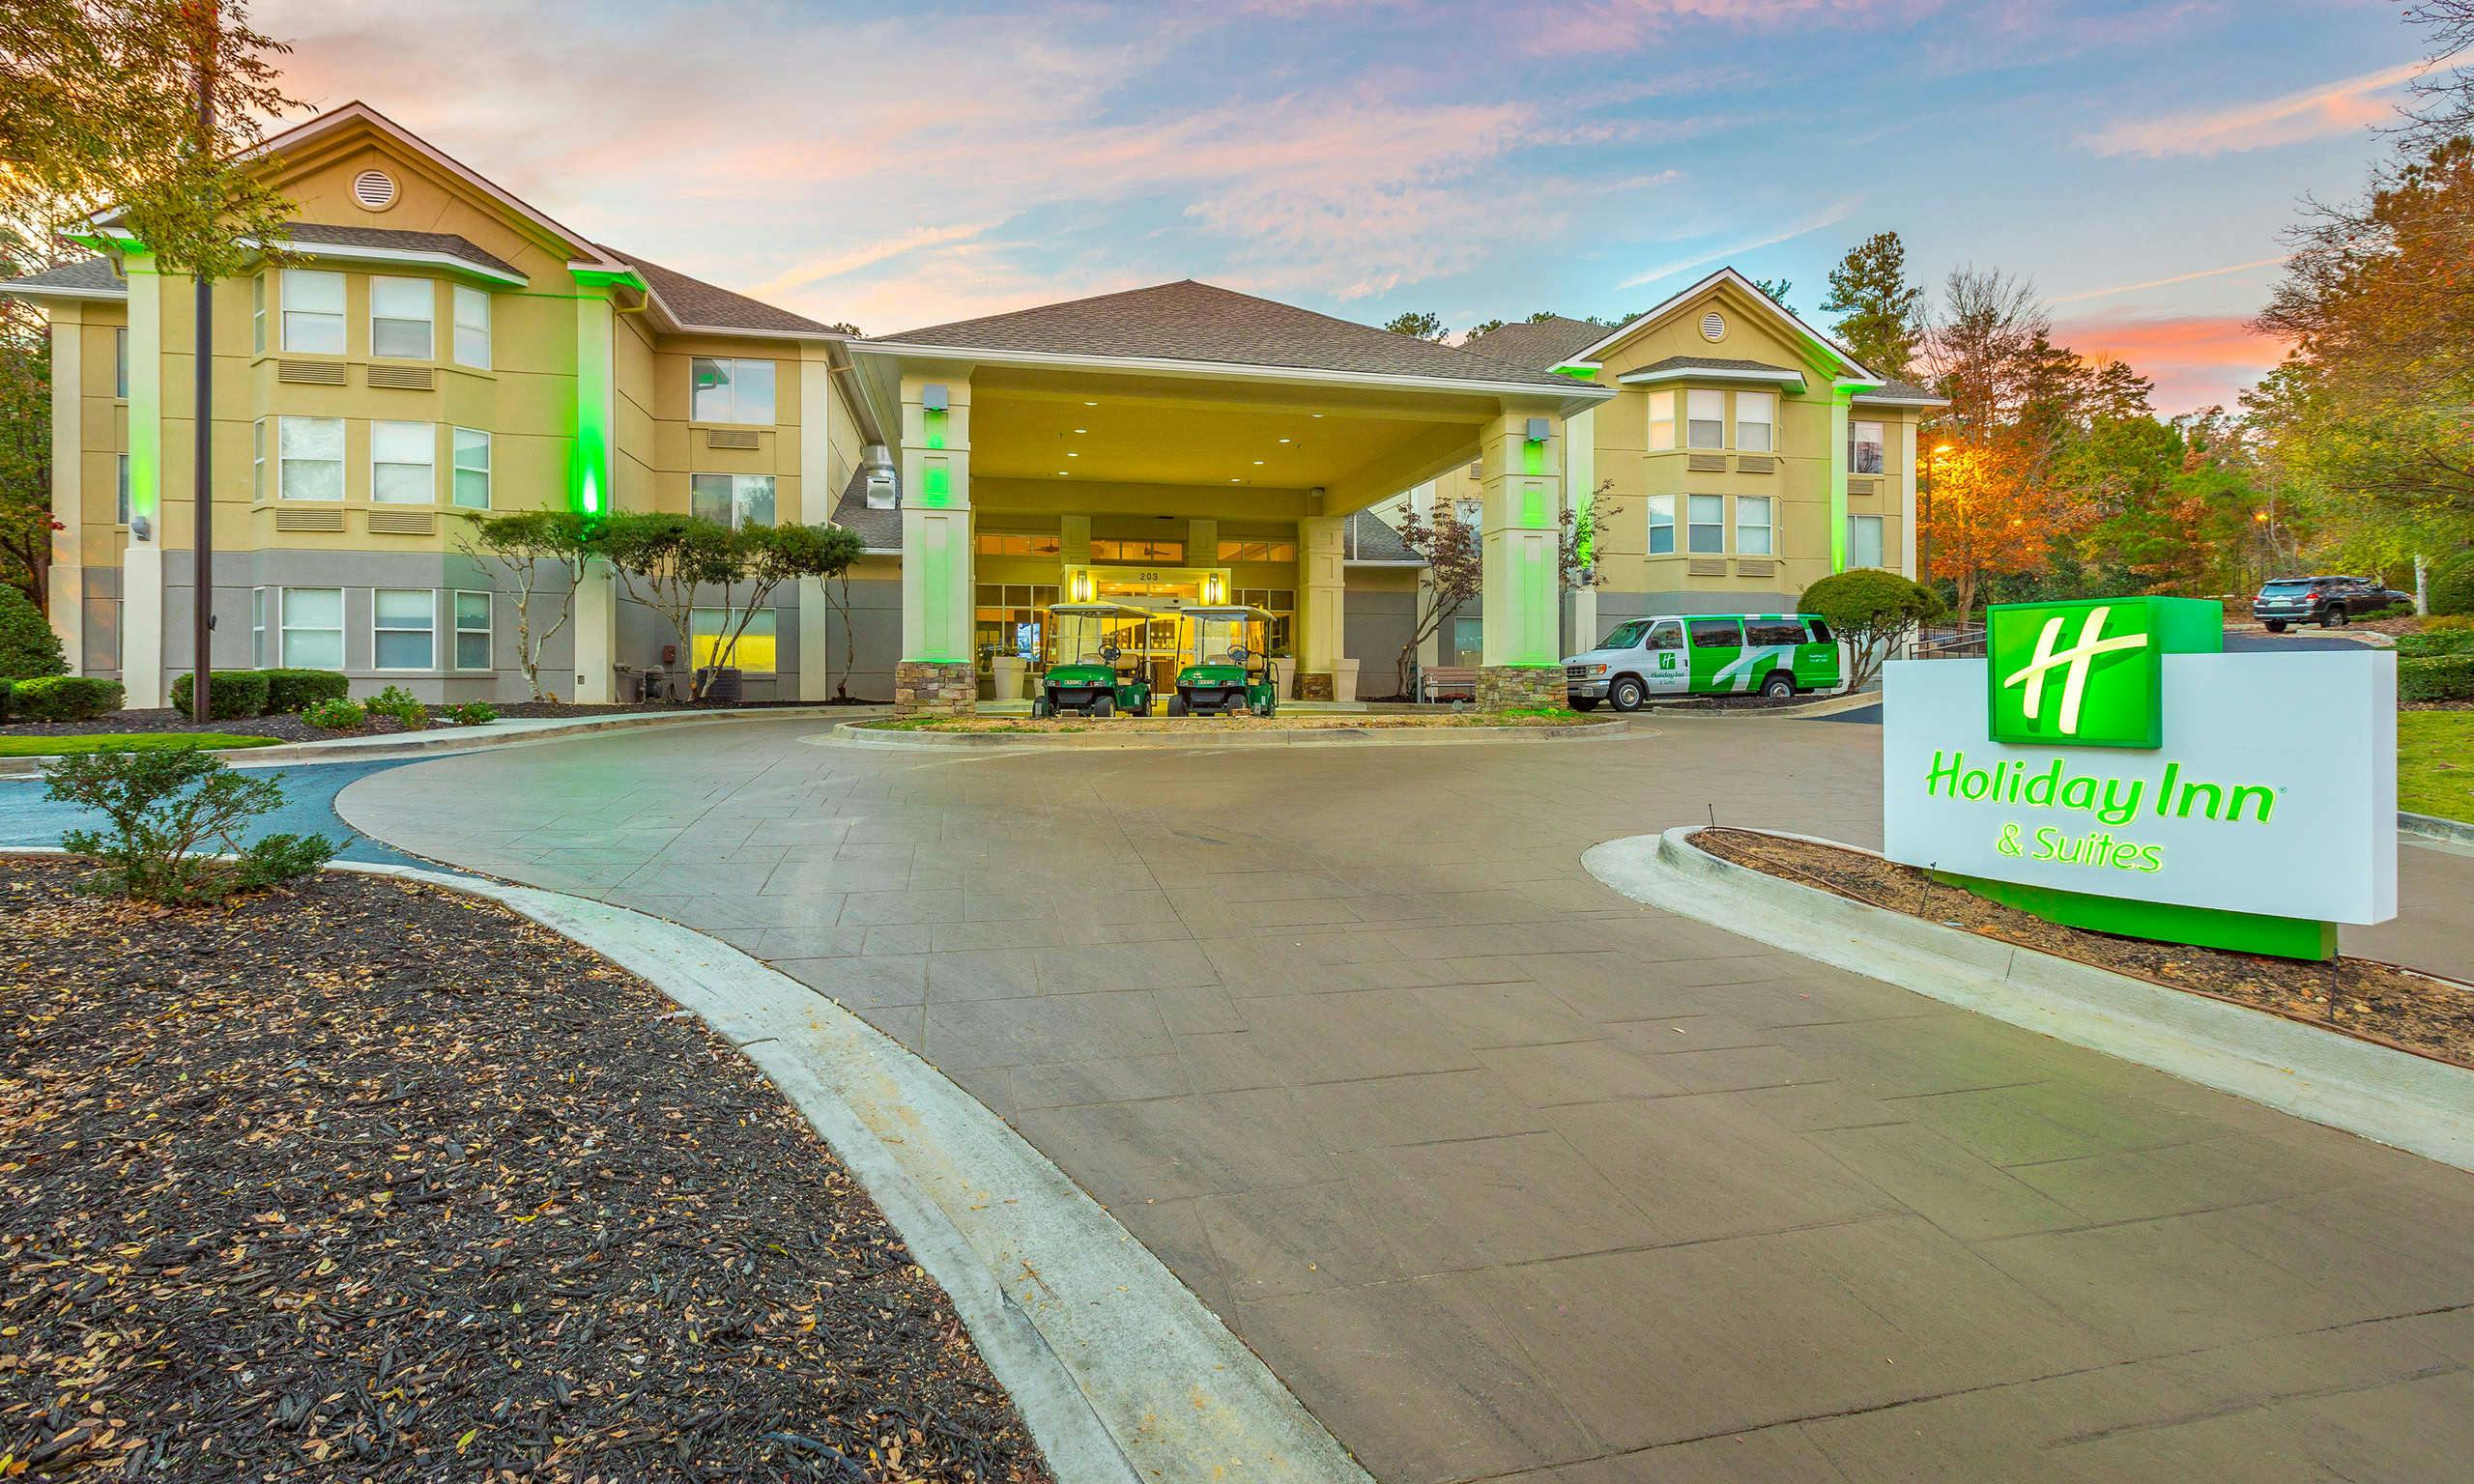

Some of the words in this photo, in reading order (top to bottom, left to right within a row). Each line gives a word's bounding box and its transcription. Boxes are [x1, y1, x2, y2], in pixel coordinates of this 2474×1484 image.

[1140, 572, 1158, 581] 203
[1925, 750, 2145, 827] Holiday
[2156, 760, 2277, 824] Inn
[1997, 822, 2023, 857] &
[2031, 825, 2164, 872] Suites
